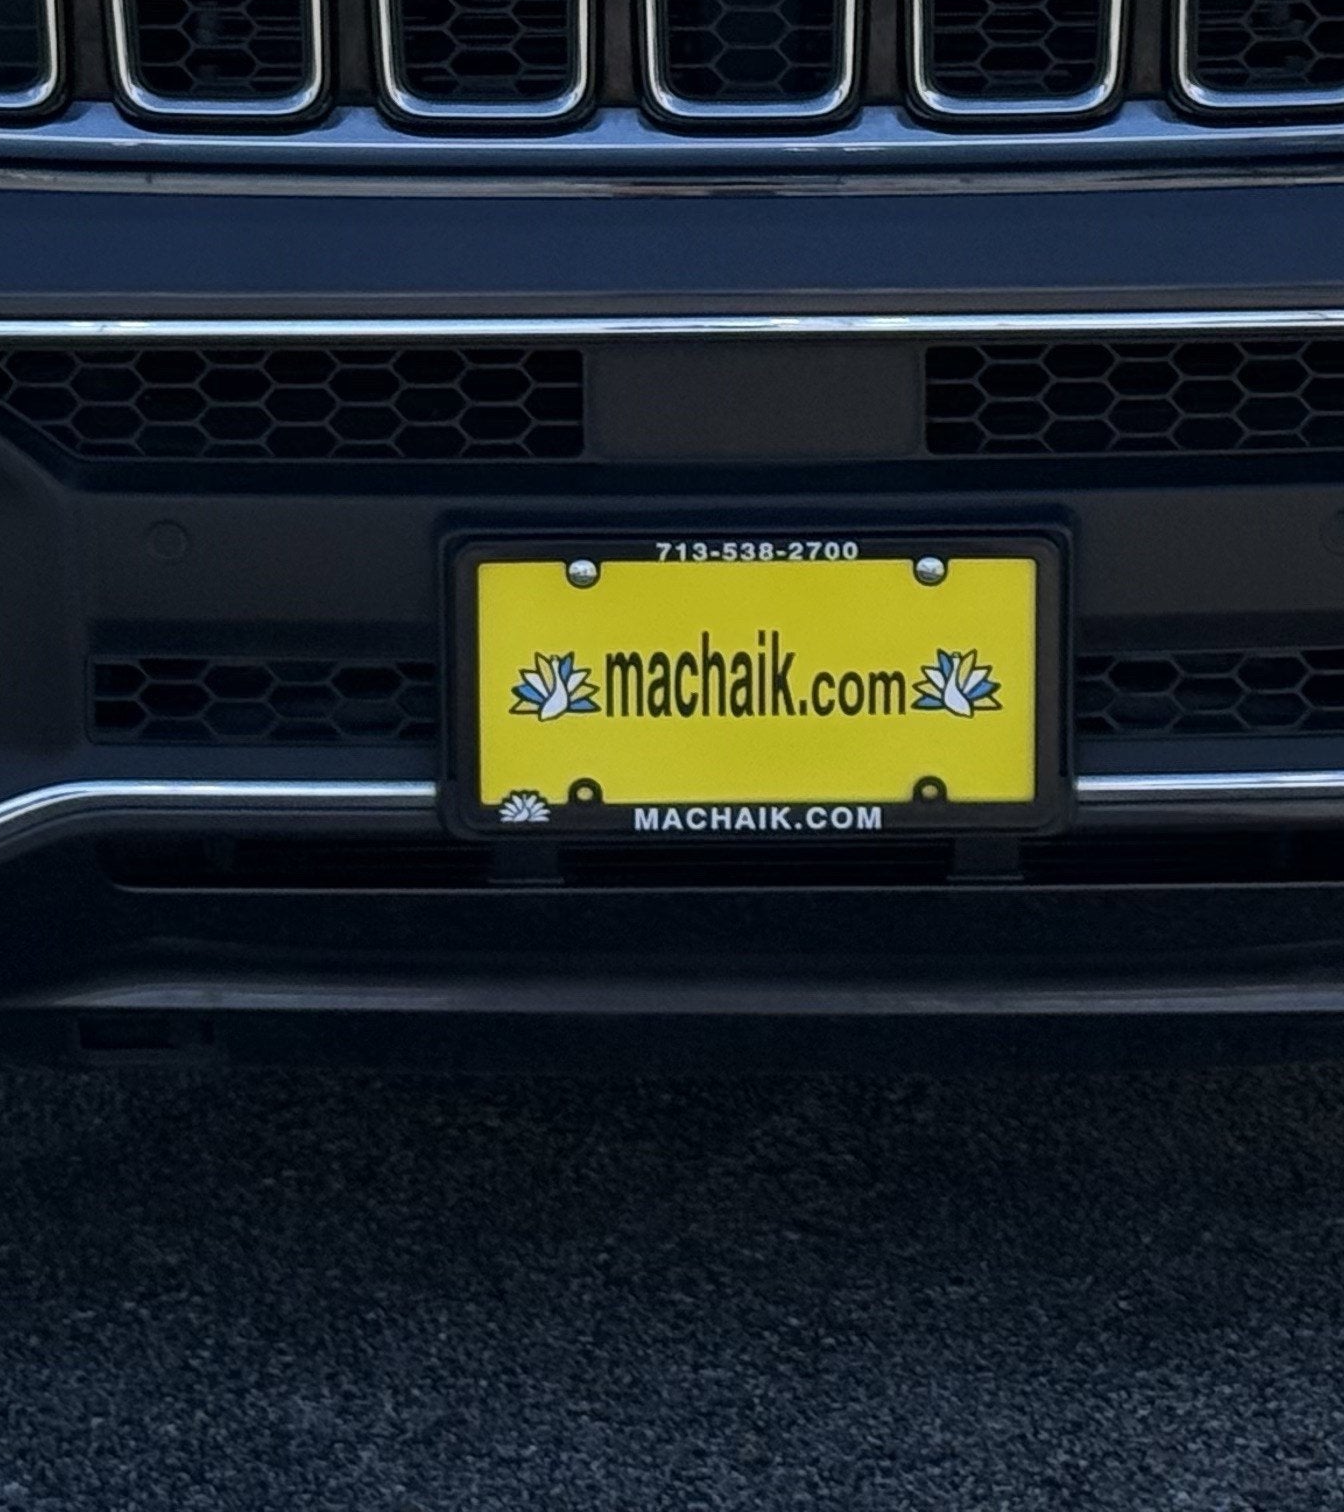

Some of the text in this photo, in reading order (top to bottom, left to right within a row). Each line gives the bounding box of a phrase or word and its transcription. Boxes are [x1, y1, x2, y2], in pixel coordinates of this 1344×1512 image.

[655, 541, 859, 562] 713-538-2700
[605, 629, 907, 718] machaik.com
[633, 806, 883, 831] MACHAIK.COM
